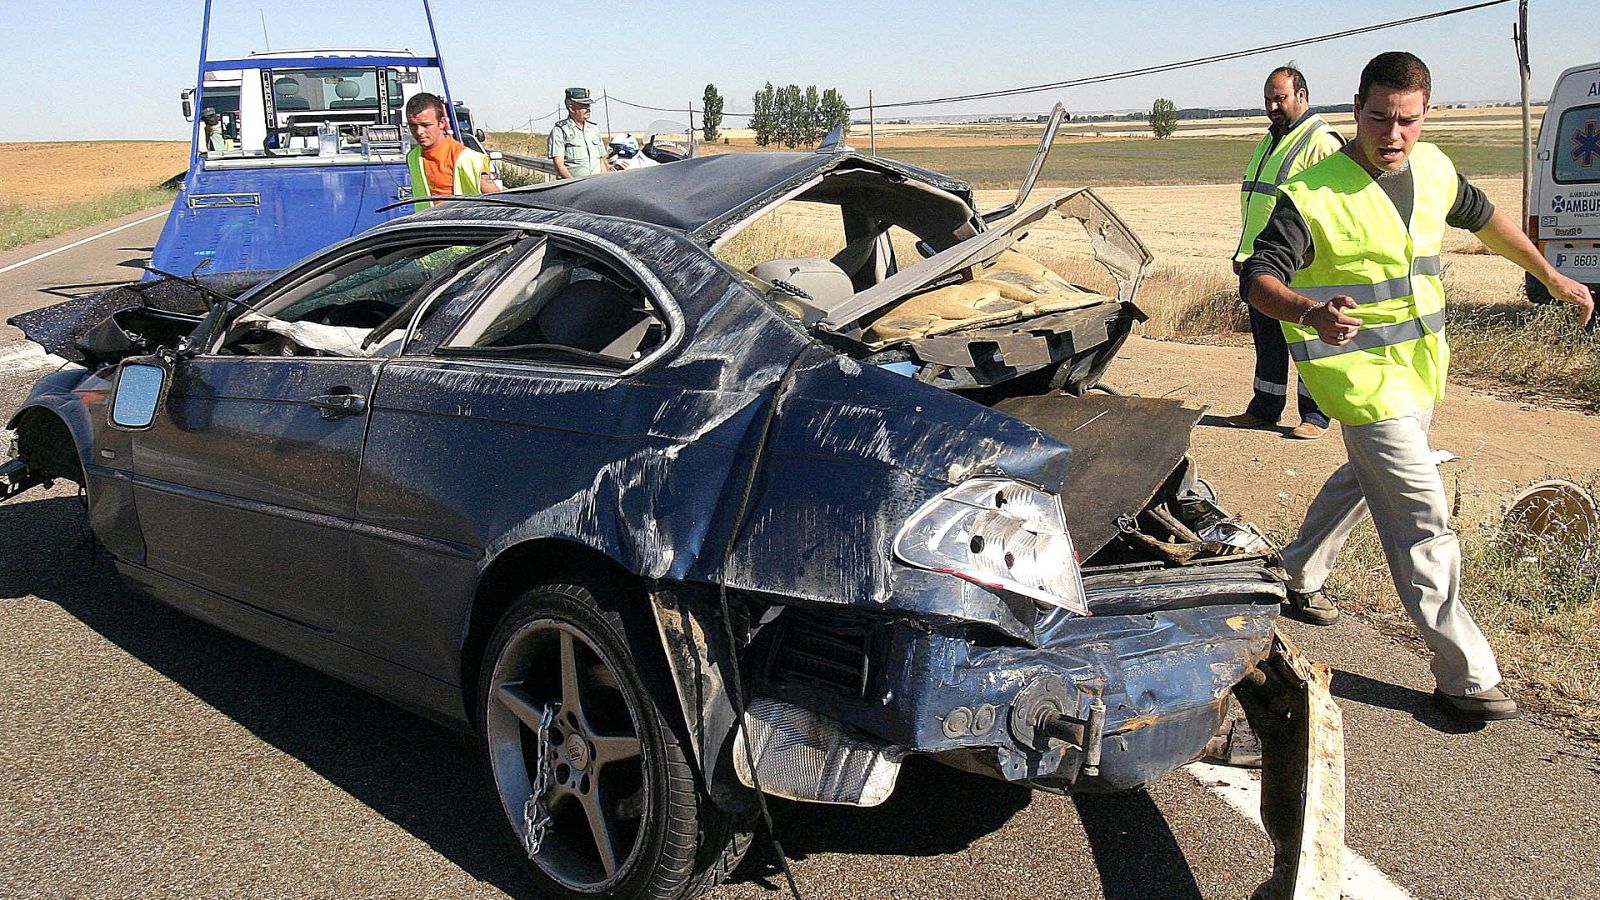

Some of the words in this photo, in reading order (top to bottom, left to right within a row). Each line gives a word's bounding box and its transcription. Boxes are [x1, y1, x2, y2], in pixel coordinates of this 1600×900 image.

[1587, 82, 1600, 97] A
[1543, 217, 1555, 226] SP
[1574, 255, 1598, 267] 8603
